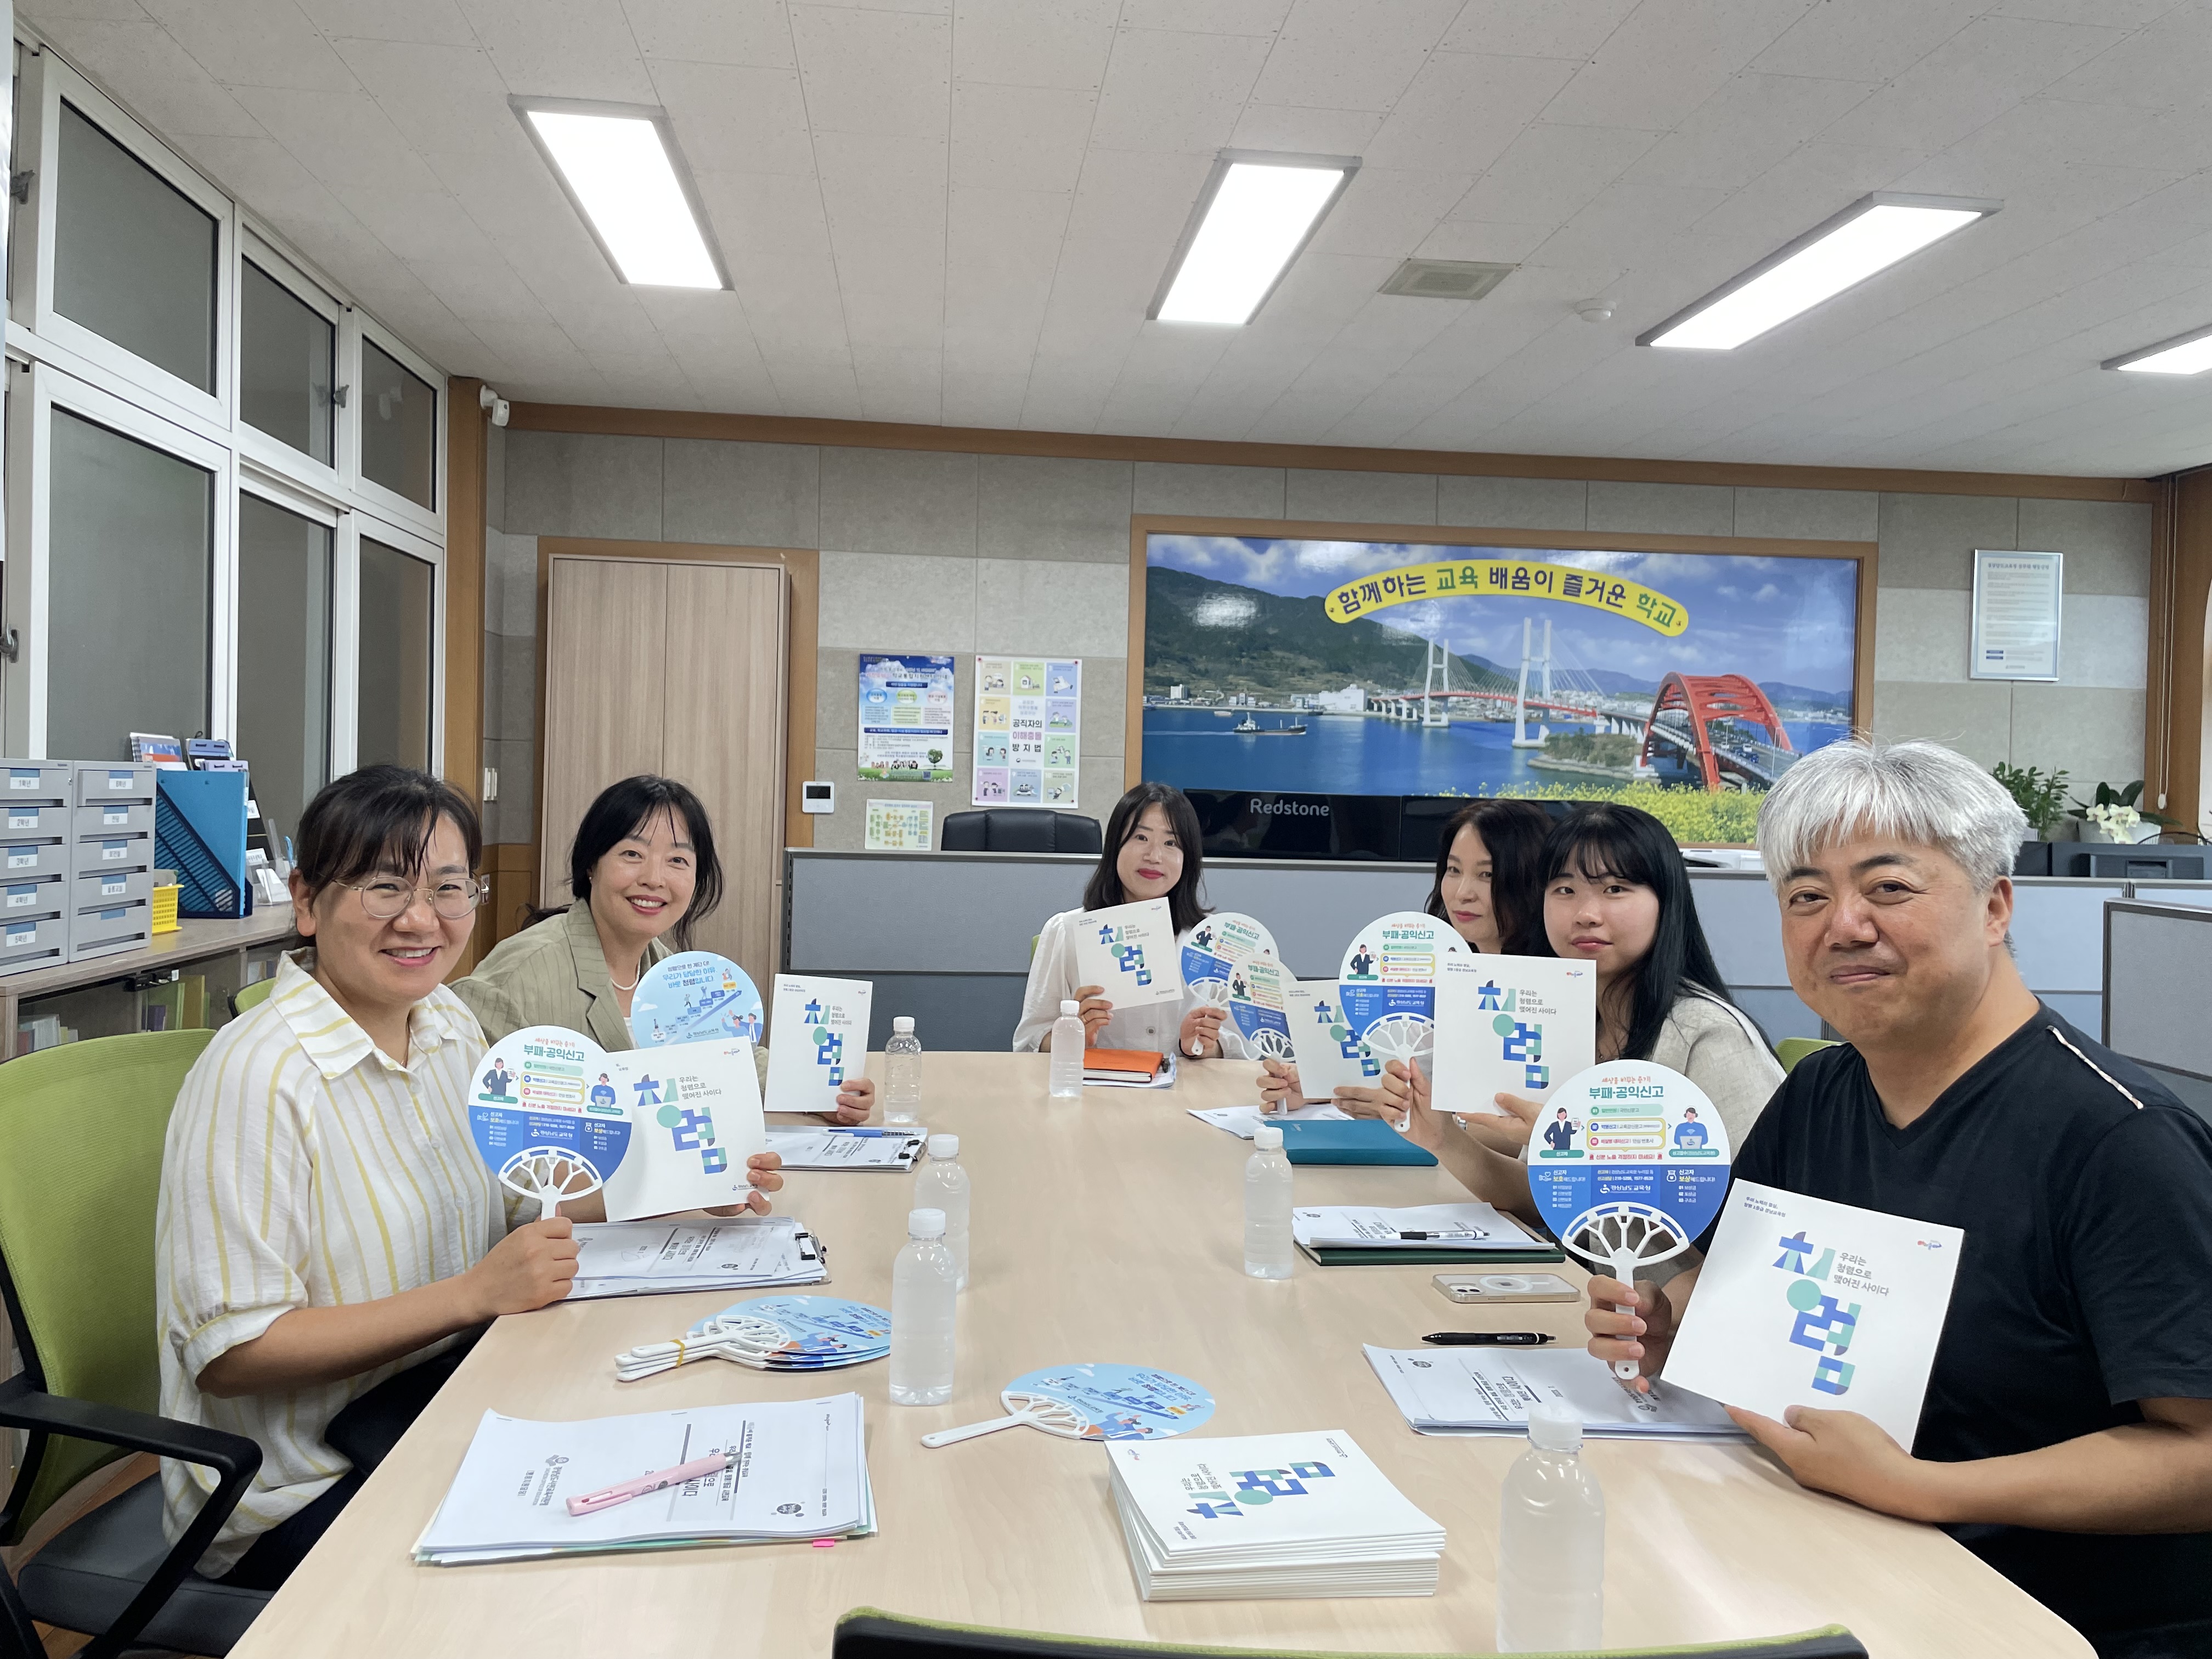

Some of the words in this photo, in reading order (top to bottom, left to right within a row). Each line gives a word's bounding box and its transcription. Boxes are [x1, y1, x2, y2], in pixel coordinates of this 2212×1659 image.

[1337, 573, 1426, 614] 함께하는
[1436, 566, 1479, 590] 교육
[1489, 566, 1554, 593] 배움이
[1562, 573, 1626, 608] 즐거운
[1636, 593, 1677, 628] 학교
[1013, 719, 1042, 728] 공직자의
[1013, 731, 1041, 740] 이해충돌
[1250, 798, 1330, 816] Redstone
[17, 819, 30, 827] 2학년
[1383, 930, 1434, 939] 부패·공익신고
[524, 1044, 584, 1062] 부패·공익신고
[1620, 1076, 1636, 1084] 바꾸는
[681, 1082, 707, 1092] 청렴으로
[703, 1088, 721, 1096] 사이다
[1589, 1086, 1664, 1099] 부패·공익신고
[1839, 1252, 1866, 1266] 우리는
[1837, 1263, 1872, 1279] 청렴으로
[1833, 1274, 1860, 1289] 맺어진
[1861, 1282, 1889, 1296] 사이다
[682, 1479, 701, 1497] 사이다
